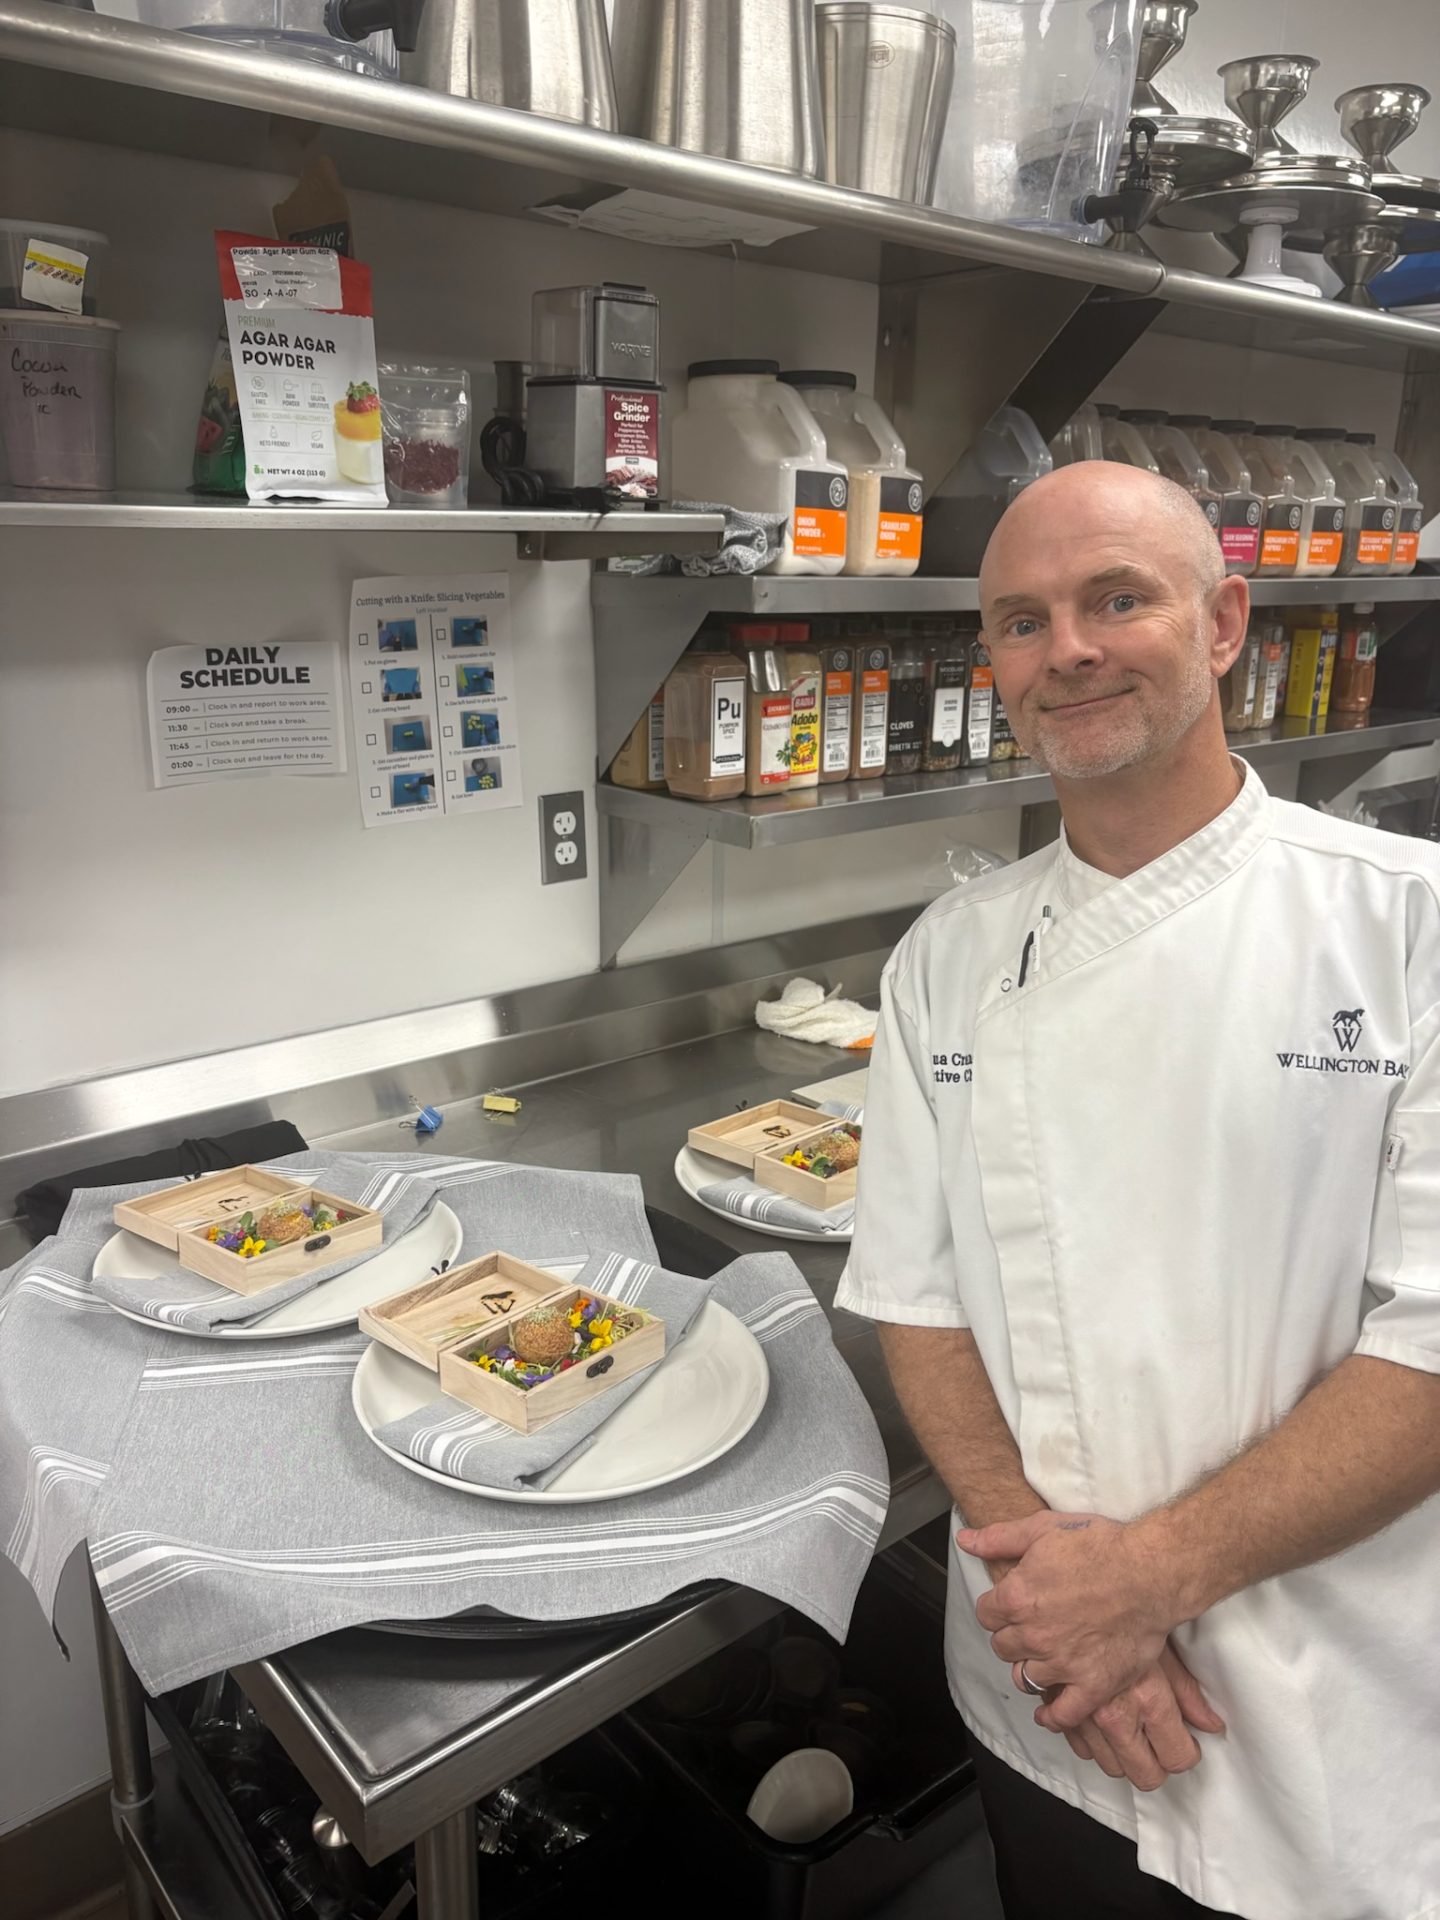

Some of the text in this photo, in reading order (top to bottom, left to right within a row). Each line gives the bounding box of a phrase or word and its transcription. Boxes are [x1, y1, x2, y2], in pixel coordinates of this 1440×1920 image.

[263, 248, 278, 256] Agar
[281, 248, 297, 256] Agar
[238, 315, 276, 328] PREMIUM
[240, 330, 336, 354] AGAR AGAR
[242, 350, 315, 370] POWDER
[621, 402, 650, 413] Spice
[614, 411, 650, 422] Grinder
[356, 596, 383, 607] Cutting
[384, 594, 404, 604] with
[437, 593, 464, 603] Slicing
[465, 590, 505, 602] Vegetables
[205, 646, 280, 666] DAILY
[180, 667, 310, 689] SCHEDULE
[166, 705, 190, 714] 09:00
[208, 702, 229, 711] Clock
[239, 701, 252, 709] and
[254, 700, 277, 709] report
[288, 699, 308, 707] work
[717, 698, 741, 720] Pu
[168, 724, 188, 732] 11:30
[209, 721, 230, 729] Clock
[231, 720, 244, 728] out
[245, 719, 259, 727] and
[260, 718, 277, 726] take
[285, 717, 308, 725] break.
[791, 712, 818, 726] Adobo
[890, 720, 914, 730] CLOVES
[169, 743, 190, 751] 11:45
[211, 739, 231, 747] Clock
[232, 738, 240, 746] in
[241, 737, 255, 745] and
[257, 736, 280, 744] return
[171, 760, 193, 769] 01:00
[212, 757, 232, 765] Clock
[234, 756, 246, 764] out
[1276, 1053, 1380, 1074] WELLINGTON
